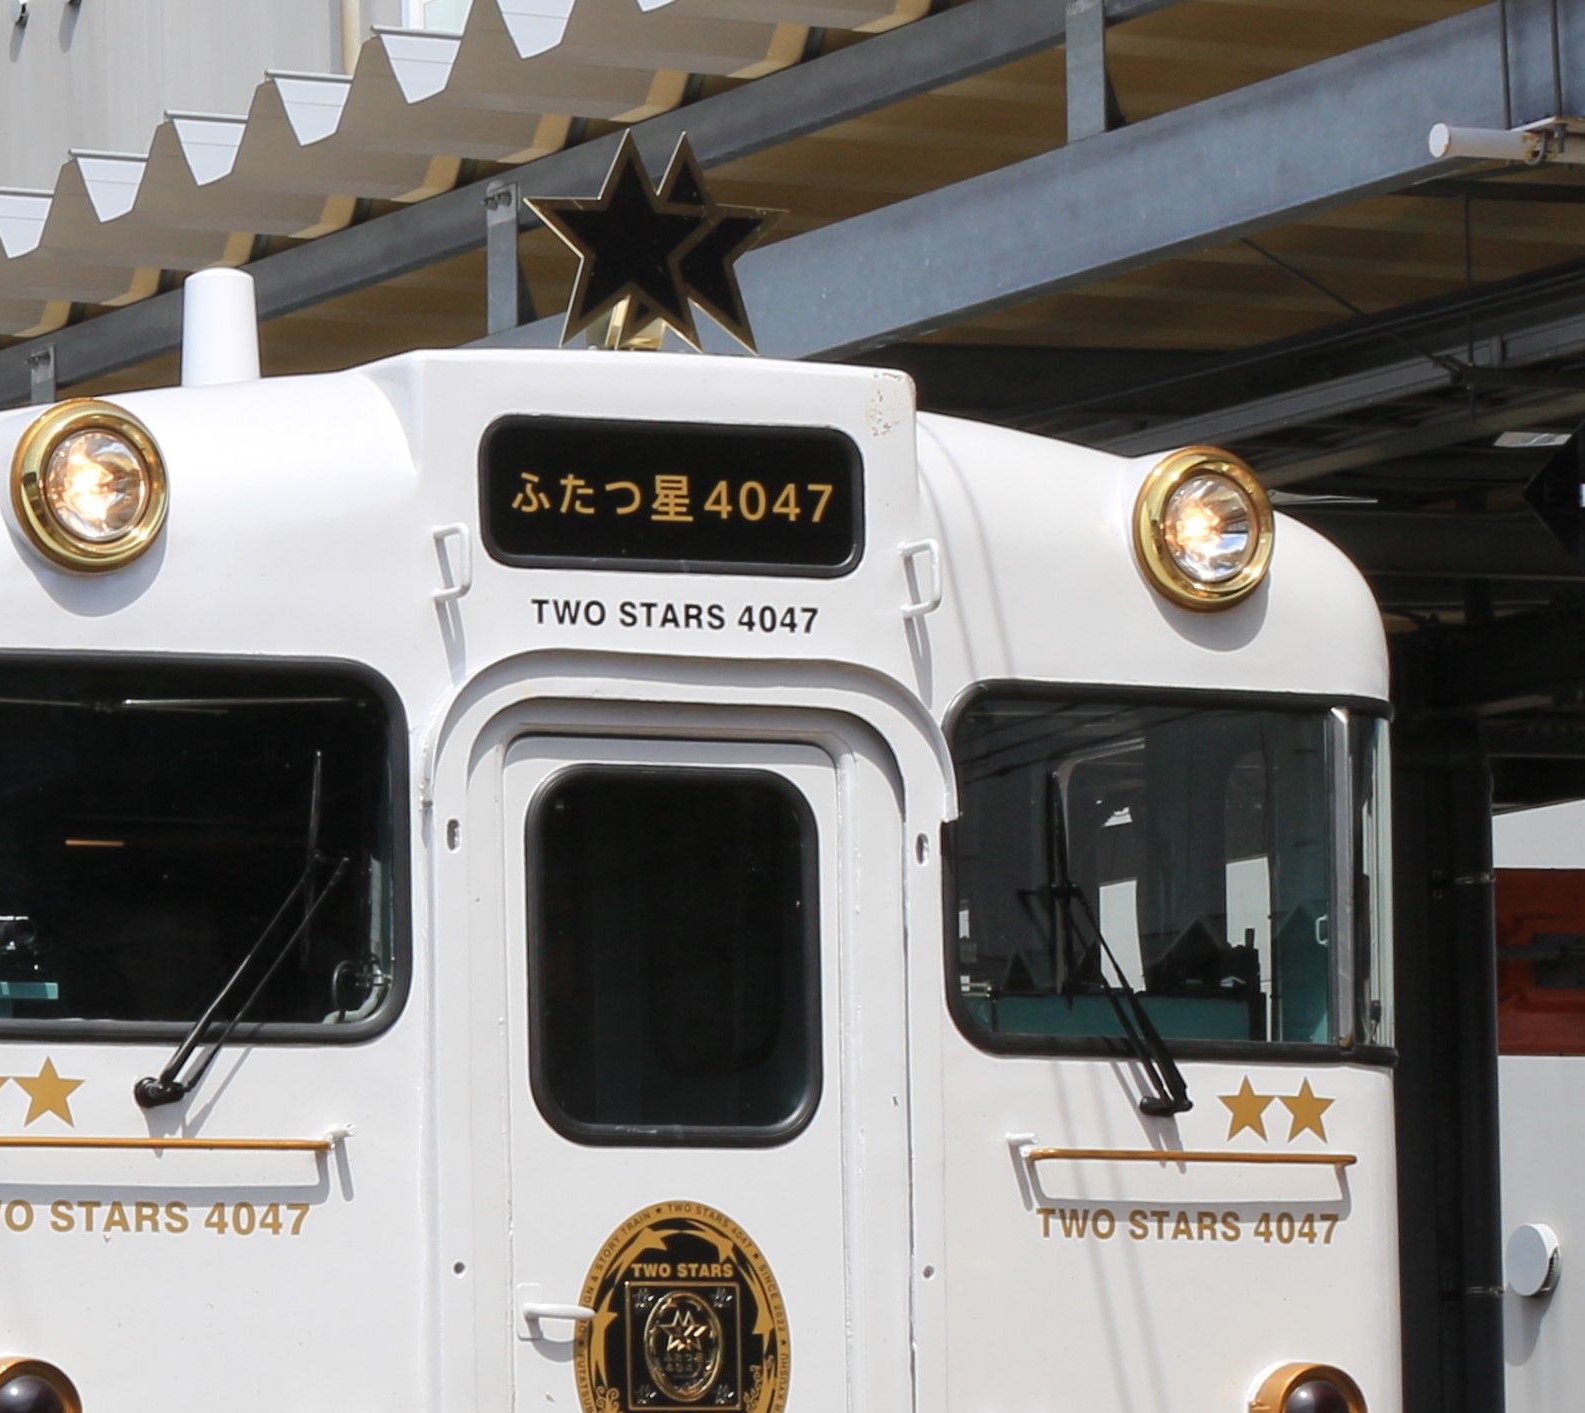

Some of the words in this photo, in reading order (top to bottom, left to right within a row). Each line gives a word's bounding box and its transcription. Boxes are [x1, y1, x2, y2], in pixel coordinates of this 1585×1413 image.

[512, 473, 833, 523] ふたつ星4047
[531, 598, 606, 629] TWO
[619, 602, 725, 631] STARS
[737, 605, 819, 634] 4047
[49, 1200, 190, 1235] STARS
[205, 1202, 310, 1237] 4047
[668, 1203, 692, 1213] TWO
[695, 1204, 729, 1228] STARS
[731, 1225, 753, 1249] 4047
[1035, 1207, 1116, 1240] TWO
[1128, 1208, 1242, 1243] STARS
[1253, 1211, 1340, 1245] 4047
[595, 1237, 620, 1273] STORY
[621, 1212, 652, 1236] TRAIN
[630, 1262, 671, 1278] TWO
[676, 1262, 734, 1278] STARS
[758, 1264, 780, 1299] SINCE
[777, 1352, 789, 1399] KYUSHU
